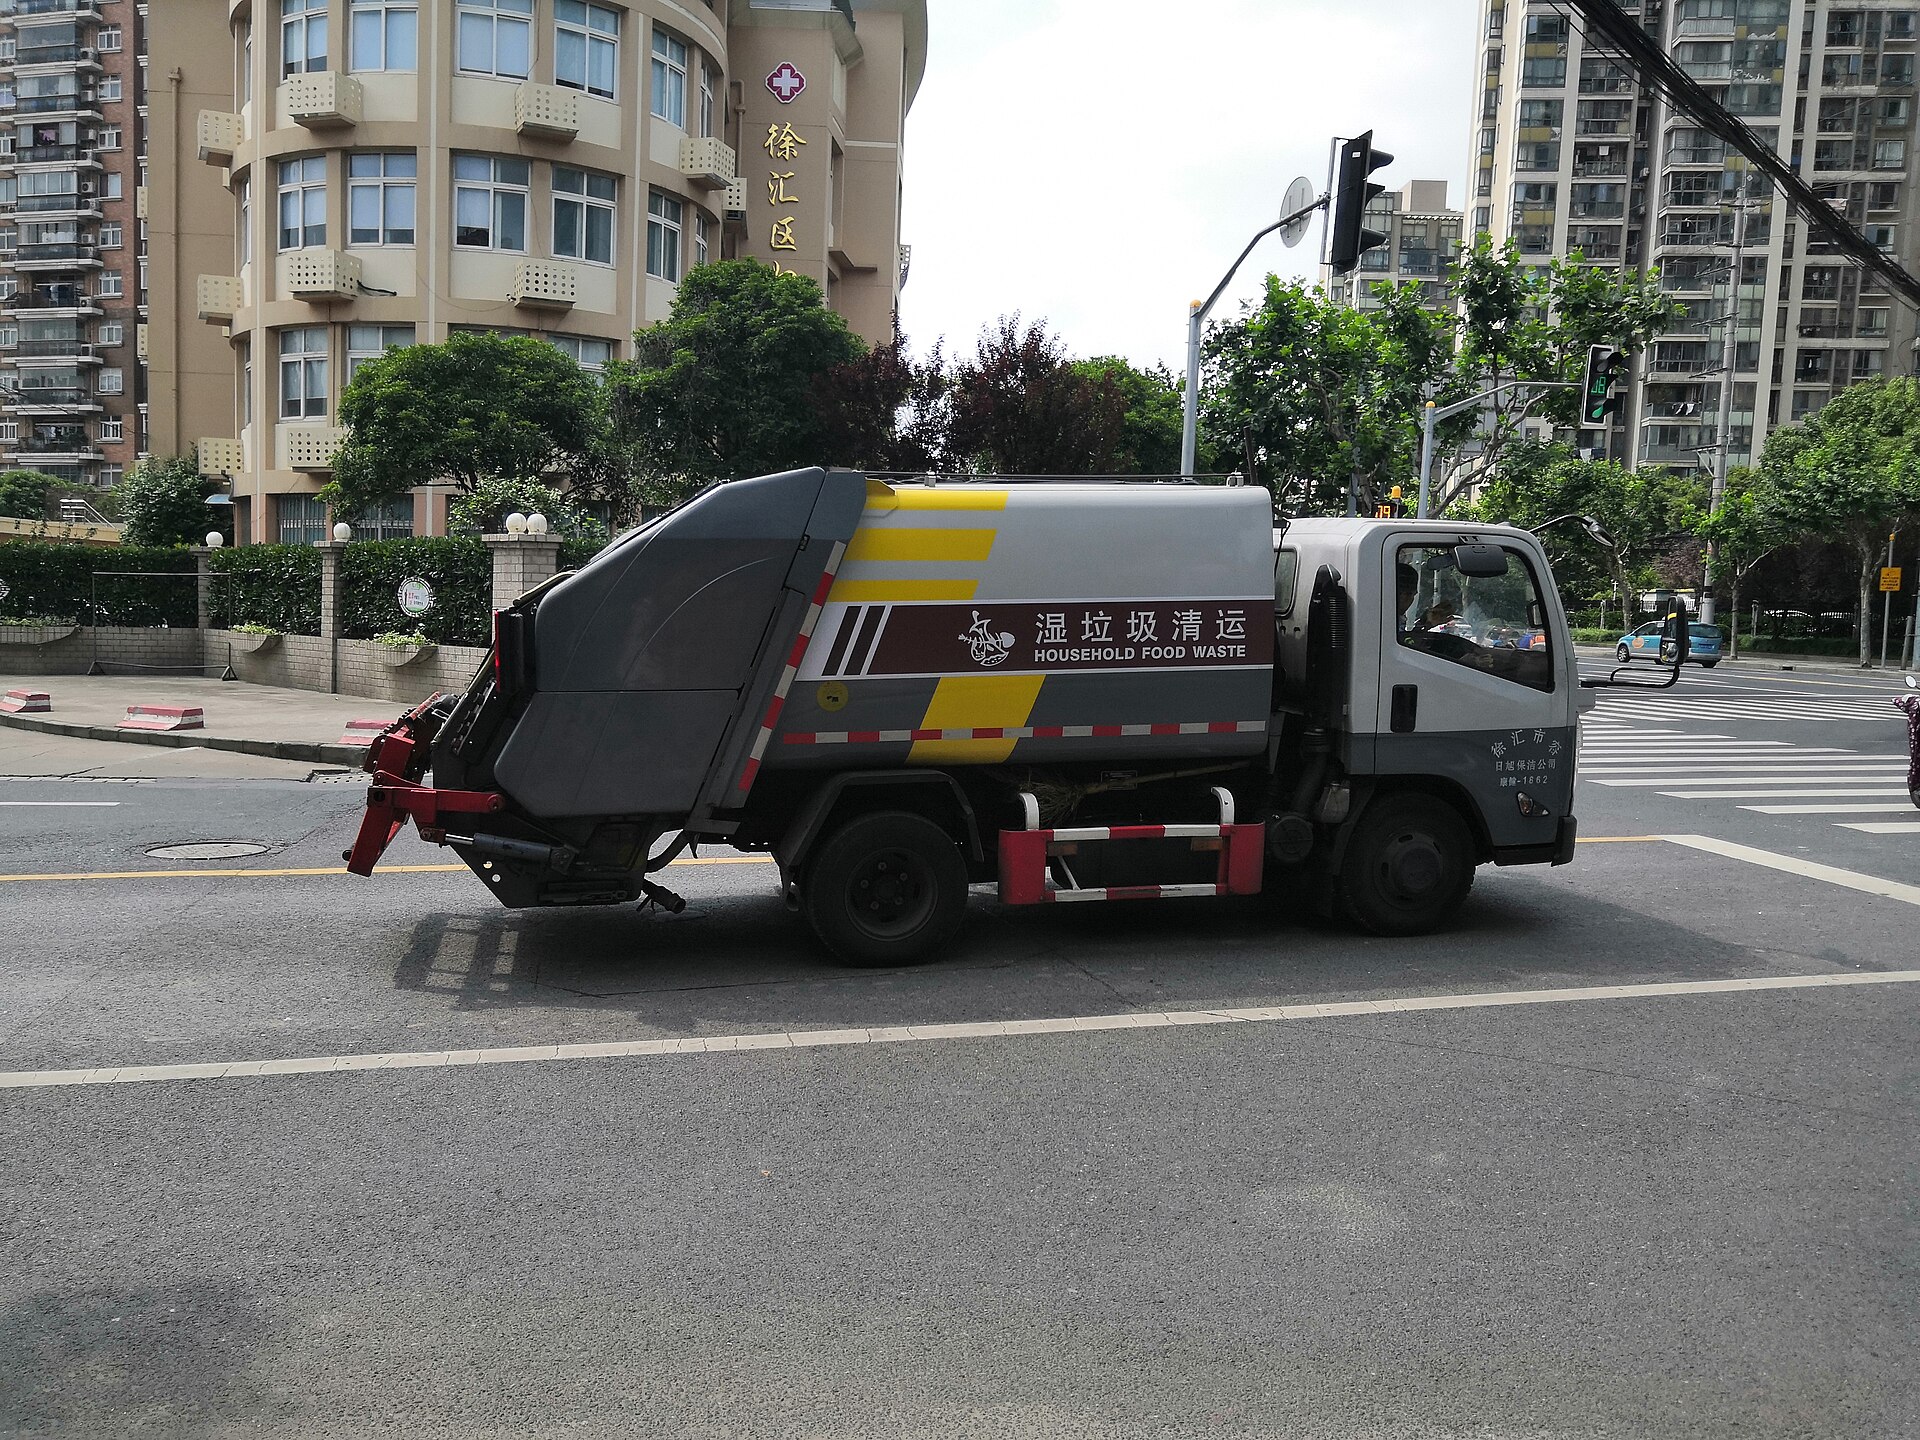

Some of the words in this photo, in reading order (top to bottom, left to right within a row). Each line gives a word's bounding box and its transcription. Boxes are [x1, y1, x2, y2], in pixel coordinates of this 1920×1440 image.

[1035, 609, 1246, 644] 湿垃圾清运
[1034, 647, 1135, 662] HOUSEHOLD
[1141, 646, 1186, 660] FOOD
[1192, 644, 1247, 659] WASTE
[1491, 728, 1562, 758] 徐汇市容
